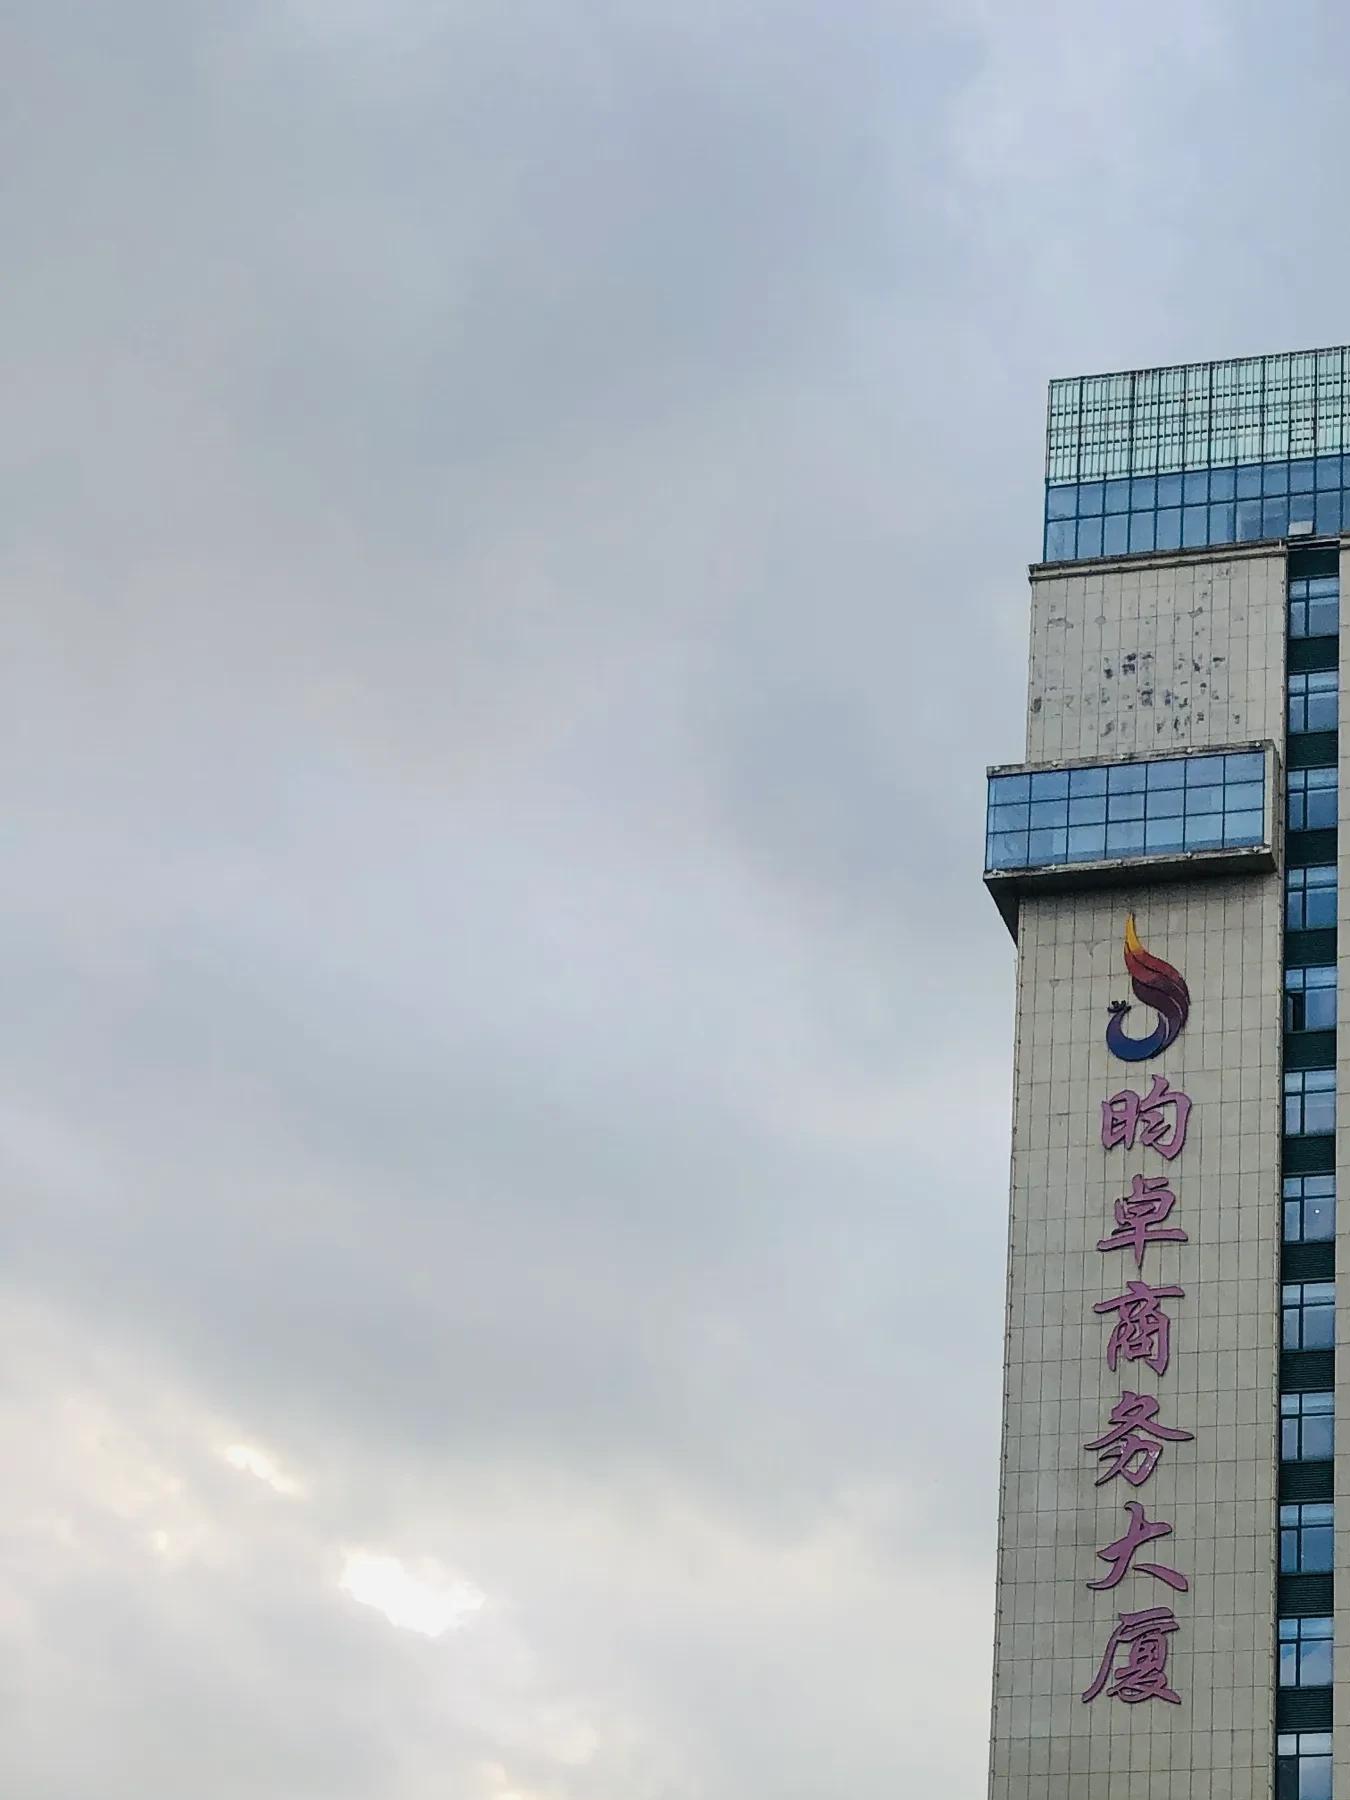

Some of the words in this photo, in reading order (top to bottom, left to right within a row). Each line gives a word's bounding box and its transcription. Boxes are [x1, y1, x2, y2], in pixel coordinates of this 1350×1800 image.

[1081, 1074, 1194, 1706] 昀卓商务大厦
